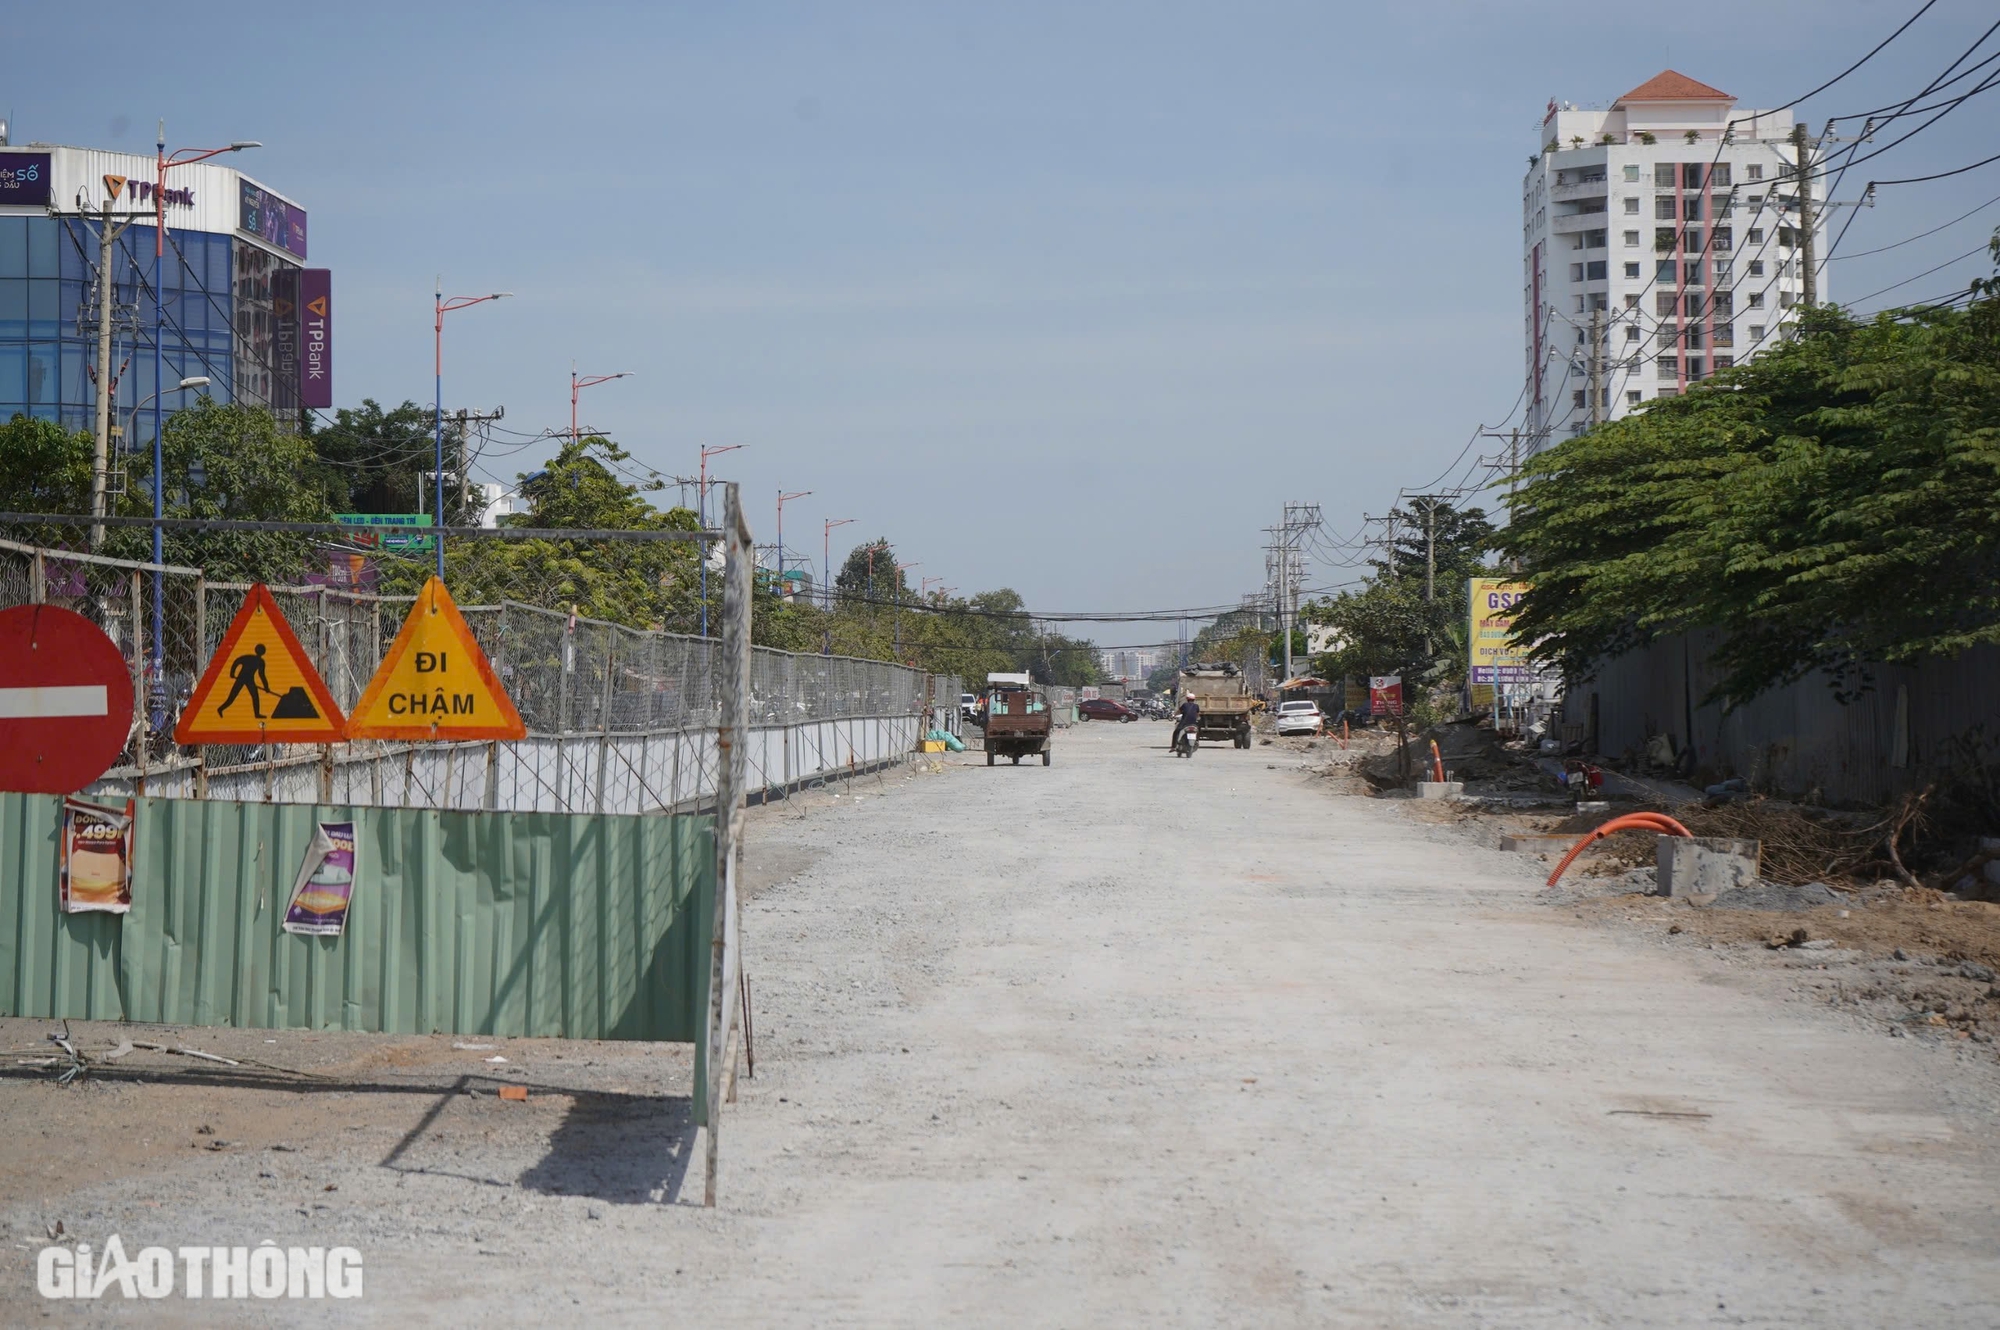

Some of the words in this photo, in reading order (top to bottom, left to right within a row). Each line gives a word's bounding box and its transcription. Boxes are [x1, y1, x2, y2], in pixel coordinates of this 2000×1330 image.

[16, 164, 39, 182] SỐ
[309, 319, 324, 380] TPBank
[415, 652, 446, 672] ĐI
[388, 687, 474, 719] CHẬM
